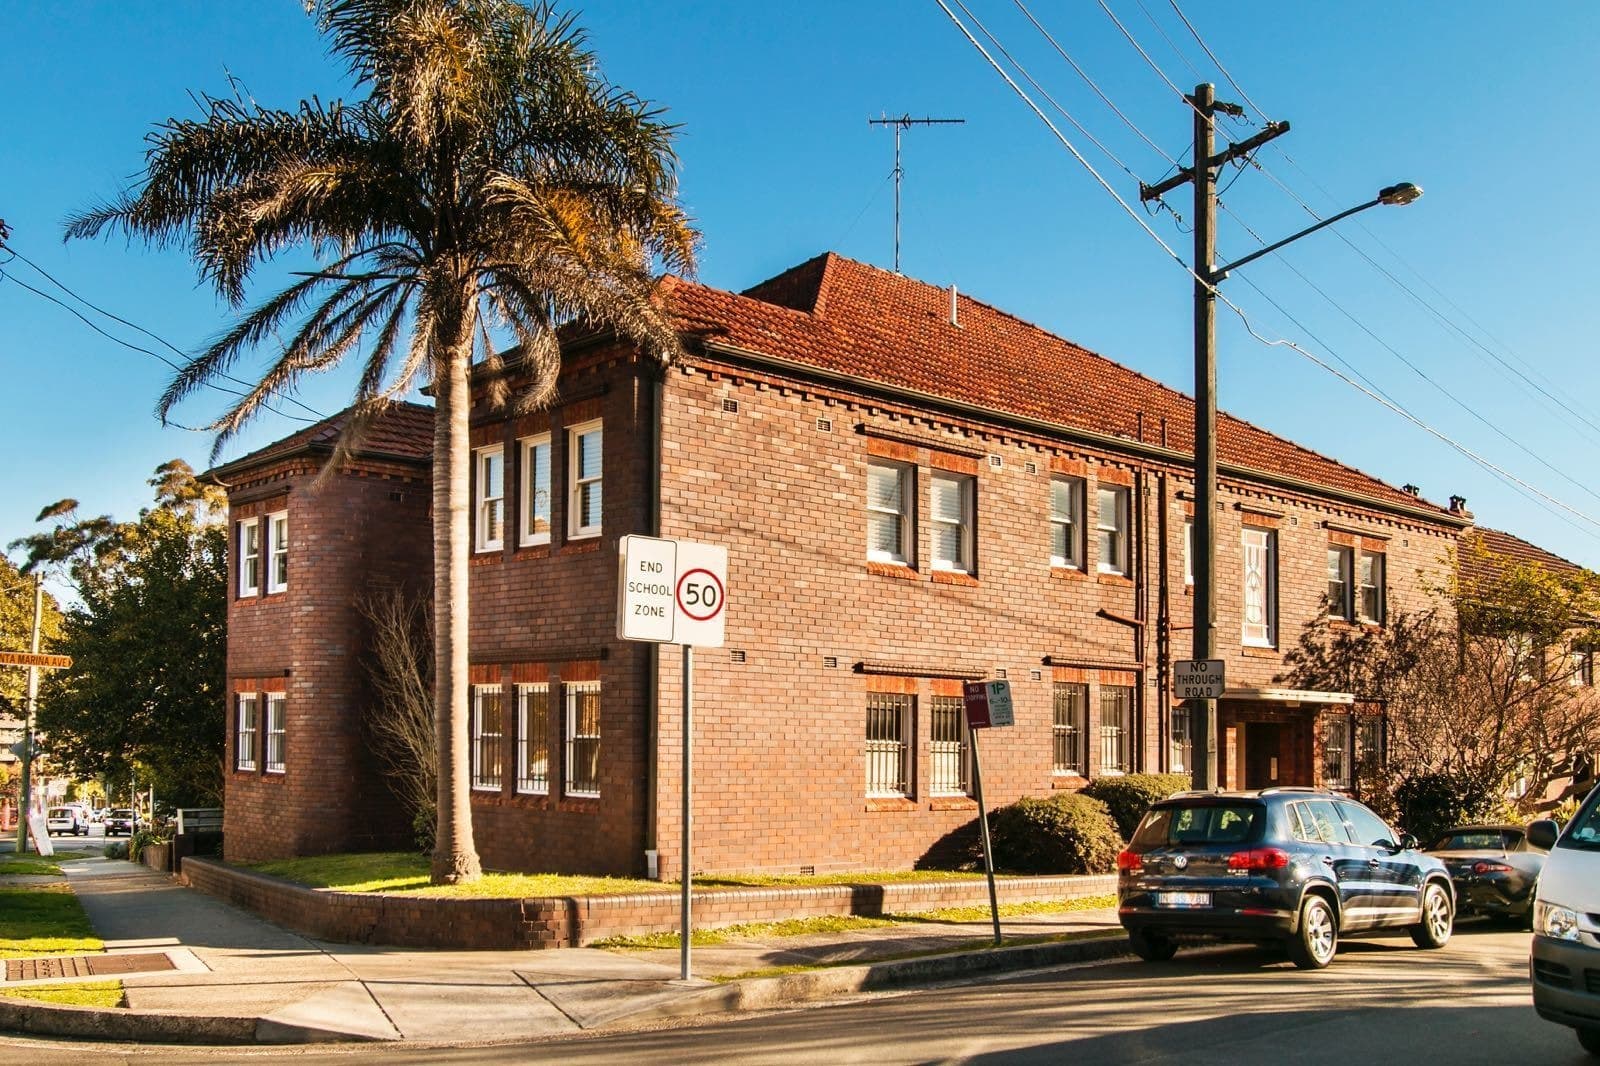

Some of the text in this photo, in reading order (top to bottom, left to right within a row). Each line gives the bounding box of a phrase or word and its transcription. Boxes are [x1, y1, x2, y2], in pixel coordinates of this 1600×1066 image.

[640, 560, 663, 574] END
[628, 581, 673, 597] SCHOOL
[686, 582, 716, 607] 50
[634, 604, 665, 618] ZONE
[52, 657, 66, 667] AVE
[1190, 662, 1208, 672] NO
[1177, 674, 1222, 685] THROUGH
[992, 682, 1006, 695] 1P
[1185, 687, 1213, 697] ROAD
